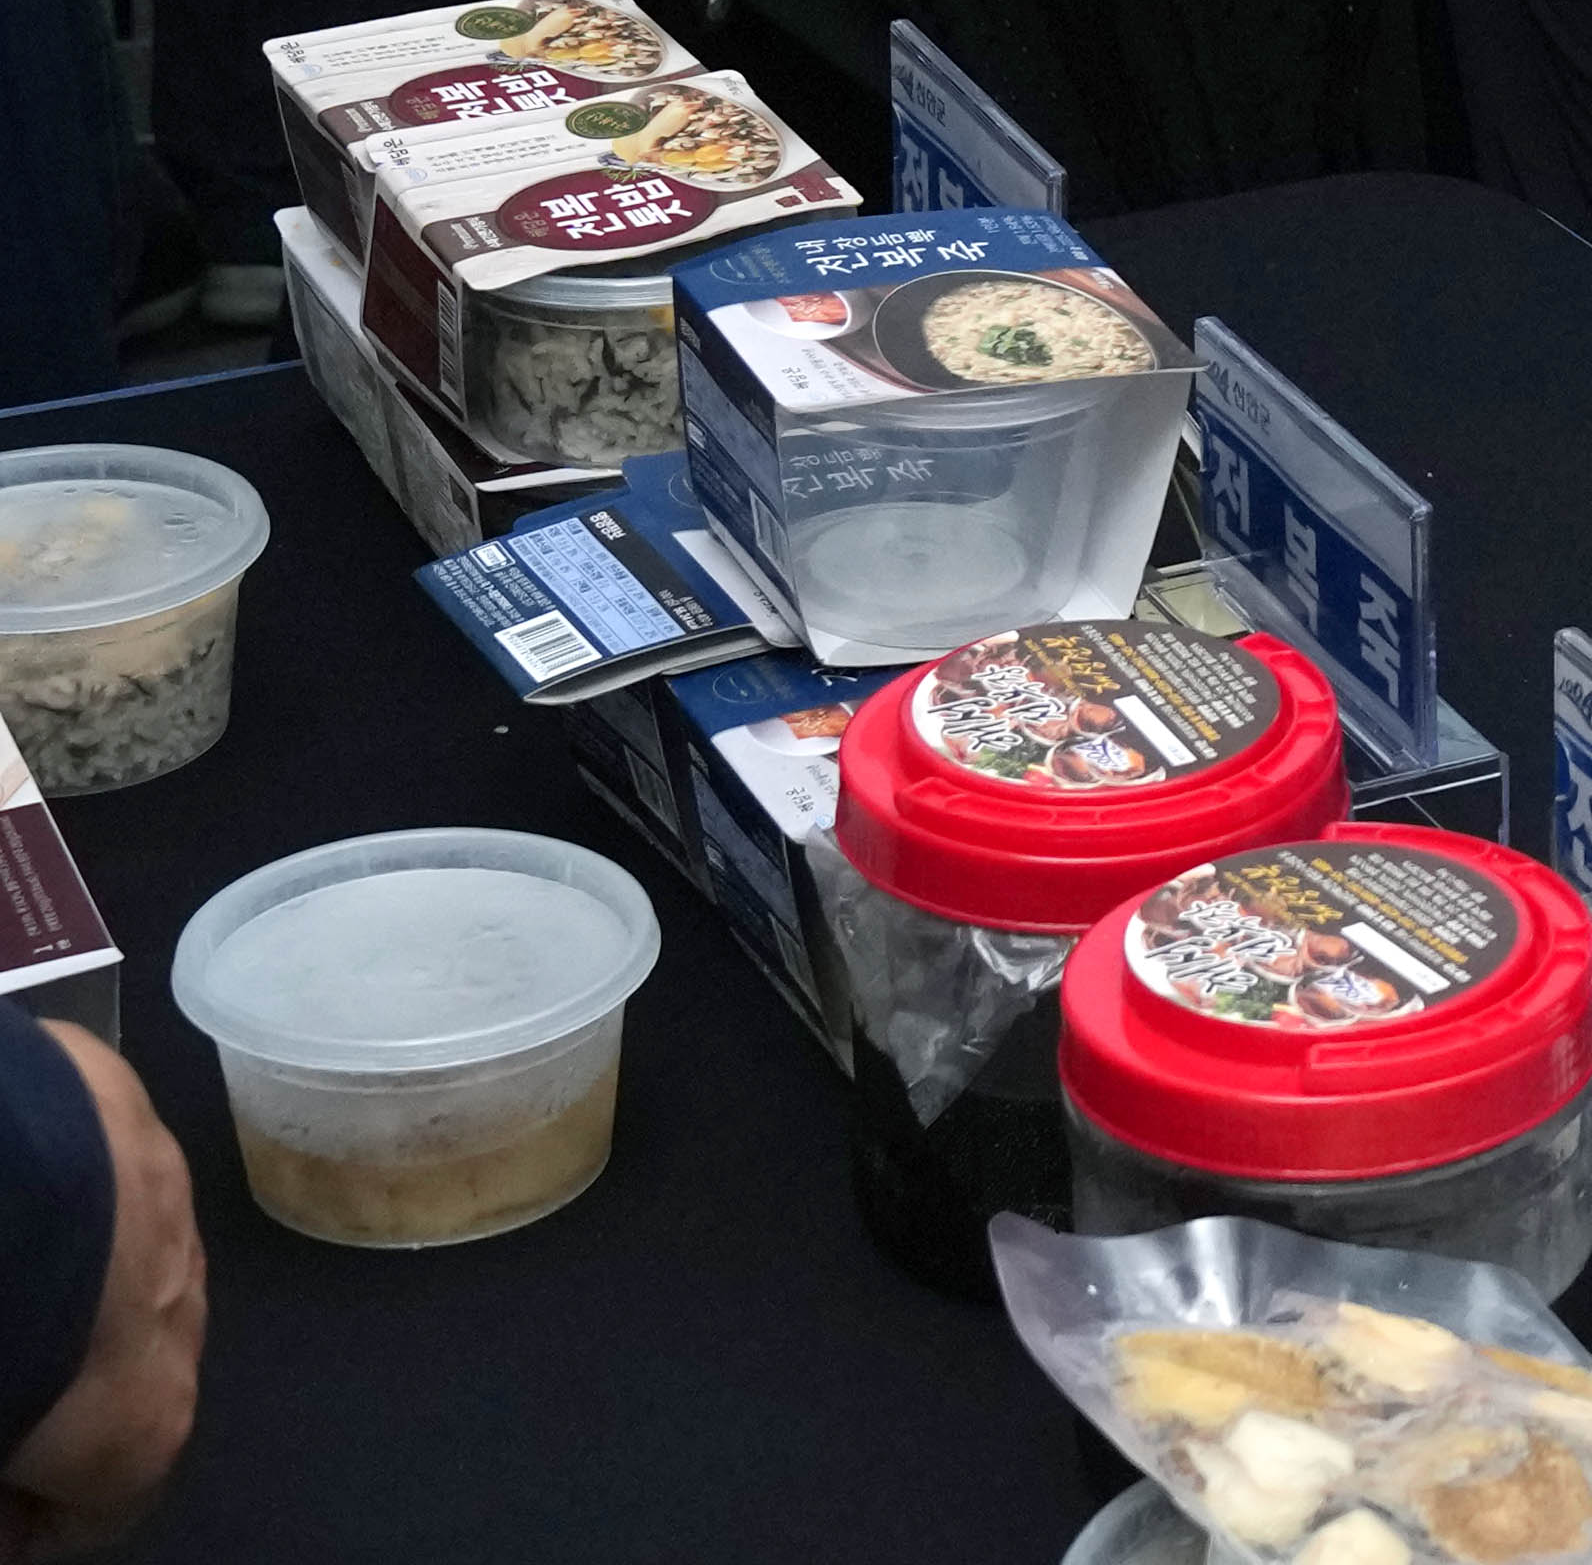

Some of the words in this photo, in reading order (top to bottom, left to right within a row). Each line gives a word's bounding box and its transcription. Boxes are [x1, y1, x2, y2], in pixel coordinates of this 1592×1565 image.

[539, 192, 618, 241] 전복
[603, 177, 695, 230] 톳밥
[806, 241, 990, 277] 전복죽
[1232, 380, 1272, 435] 신안군
